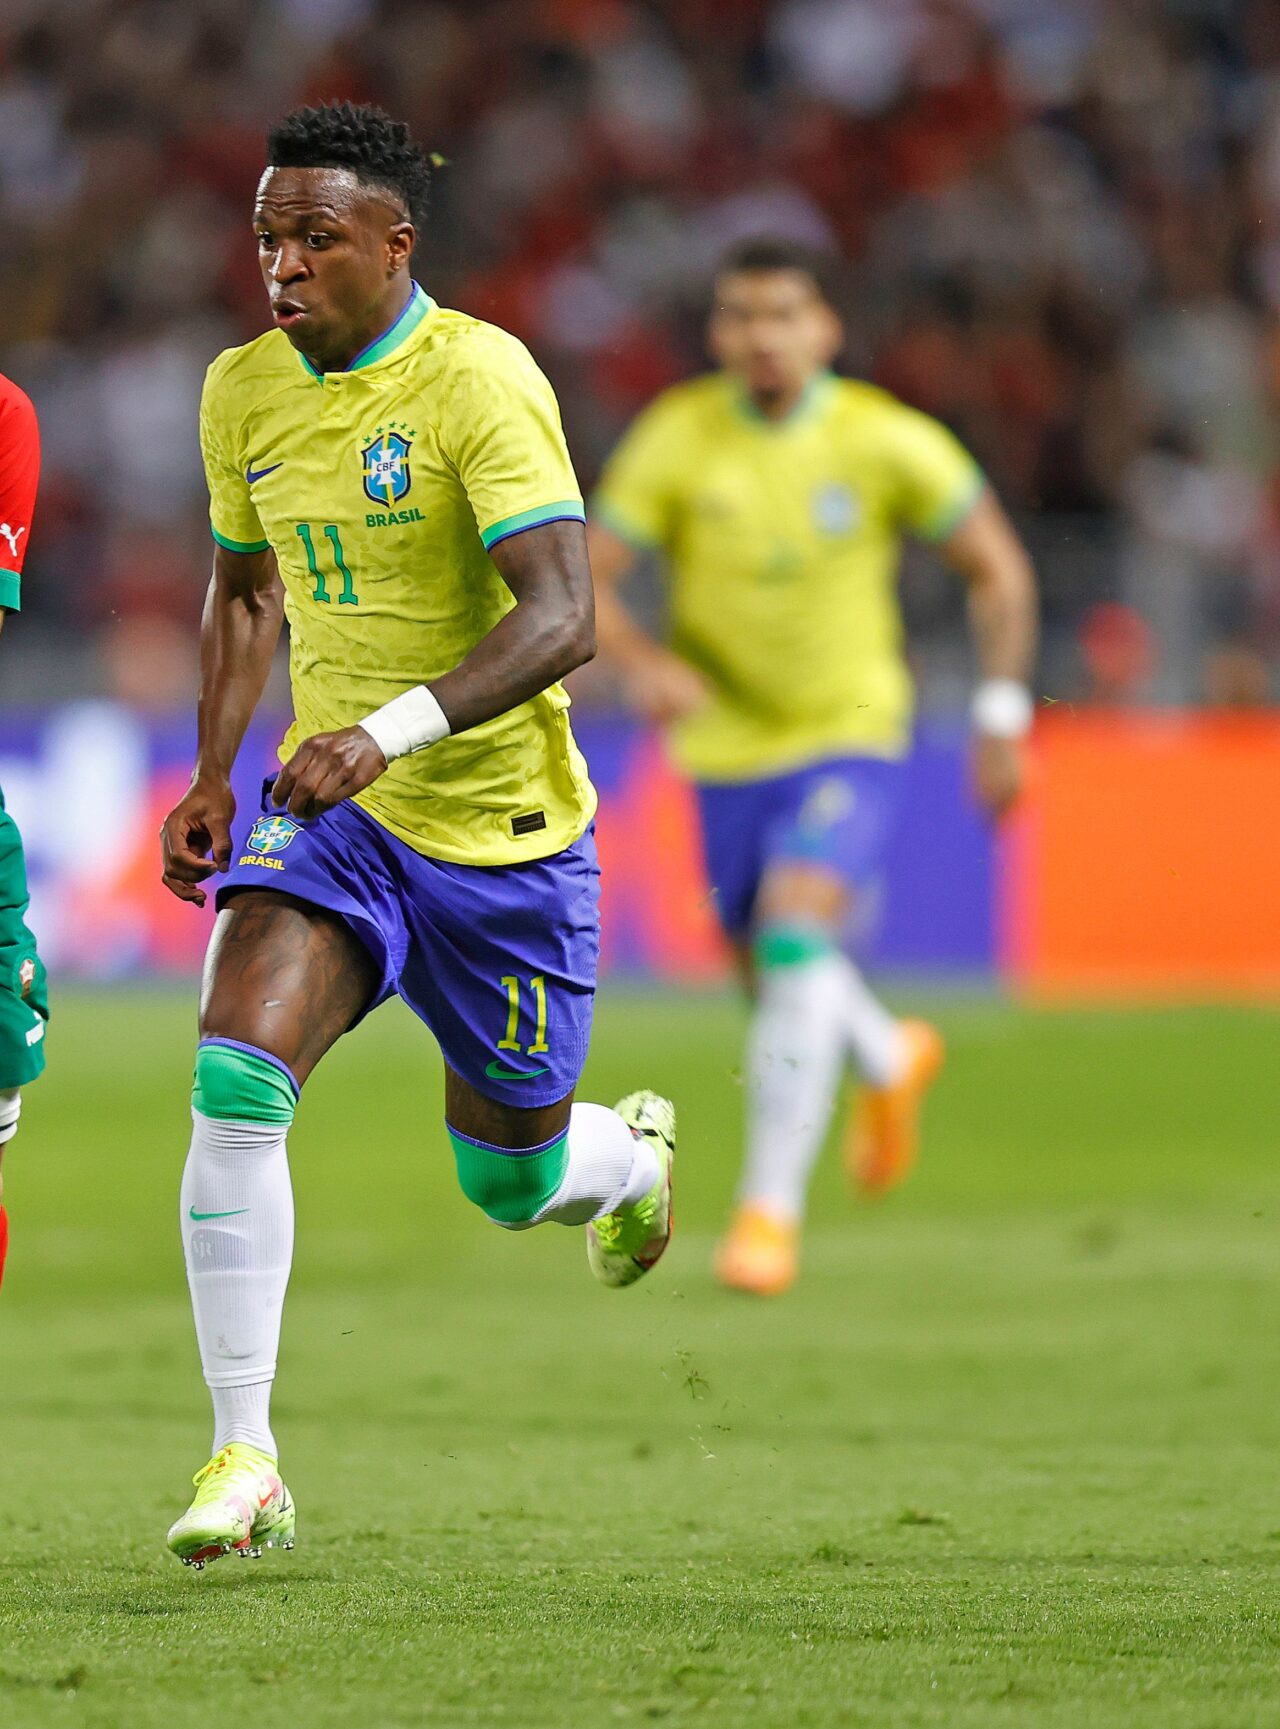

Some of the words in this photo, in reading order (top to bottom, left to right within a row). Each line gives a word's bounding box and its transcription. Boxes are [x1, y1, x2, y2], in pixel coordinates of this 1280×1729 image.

[376, 461, 395, 472] CBF
[365, 508, 426, 527] BRASIL
[296, 524, 359, 606] 11
[238, 855, 286, 870] BRASIL
[496, 975, 550, 1057] 11
